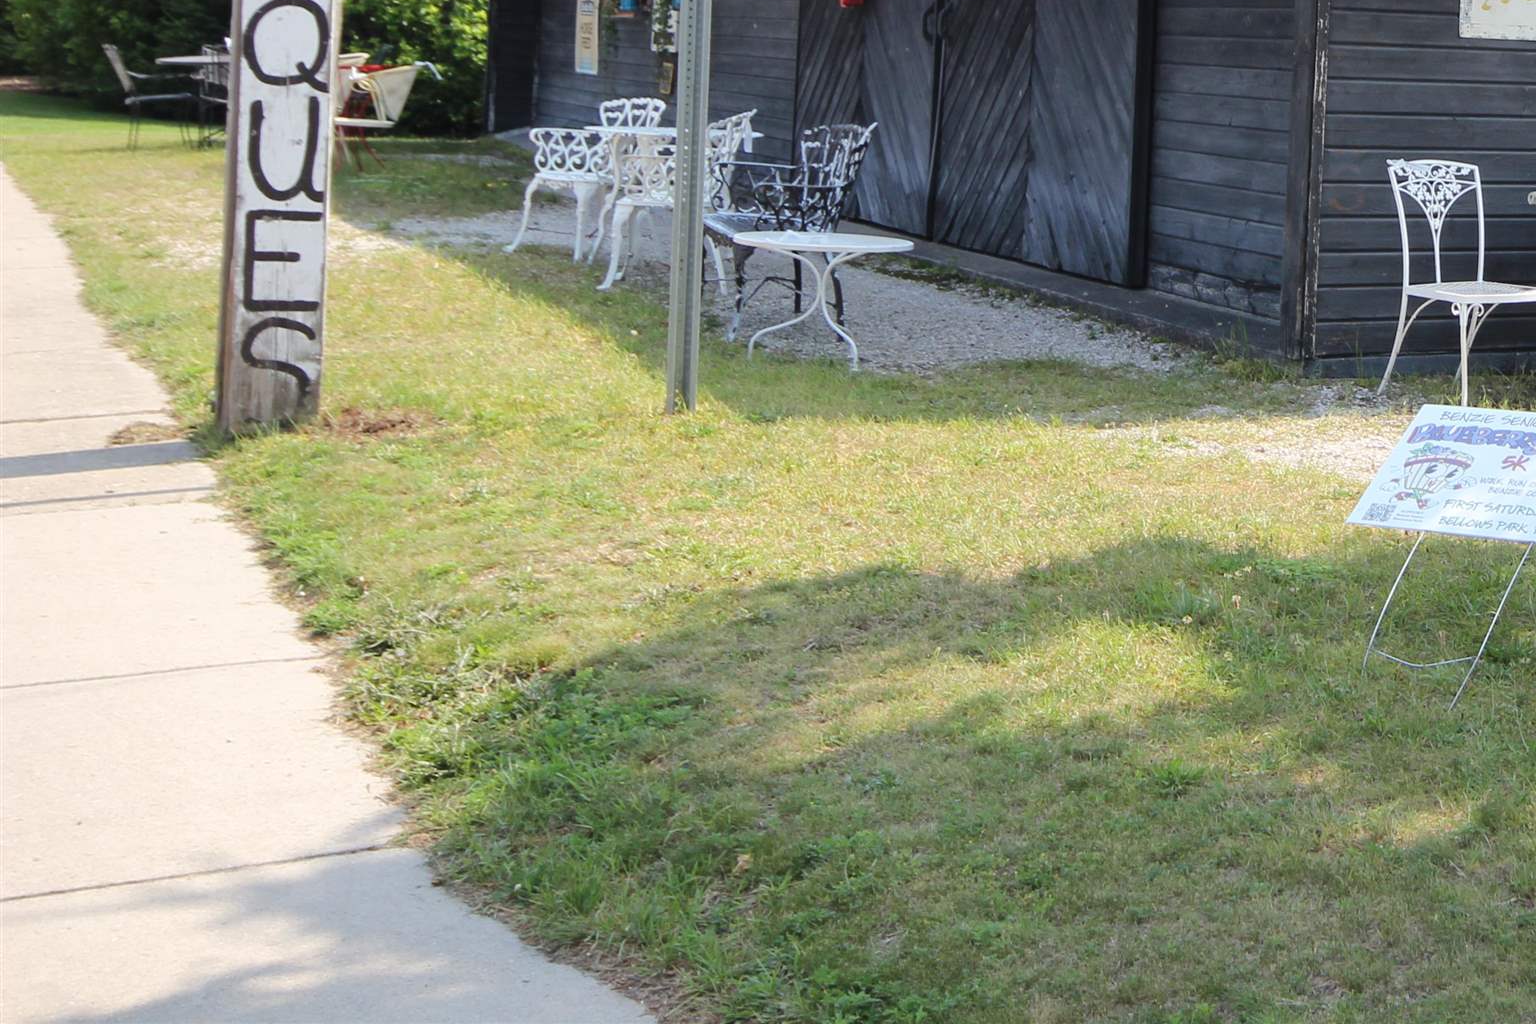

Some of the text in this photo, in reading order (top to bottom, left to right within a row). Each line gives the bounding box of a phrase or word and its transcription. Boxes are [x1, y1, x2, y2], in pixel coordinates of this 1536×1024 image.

[1440, 410, 1496, 424] BENZIE
[1501, 455, 1531, 473] 5K
[1443, 498, 1482, 510] FIRST
[1438, 515, 1494, 530] BELLOWS
[1495, 520, 1529, 535] PARK
